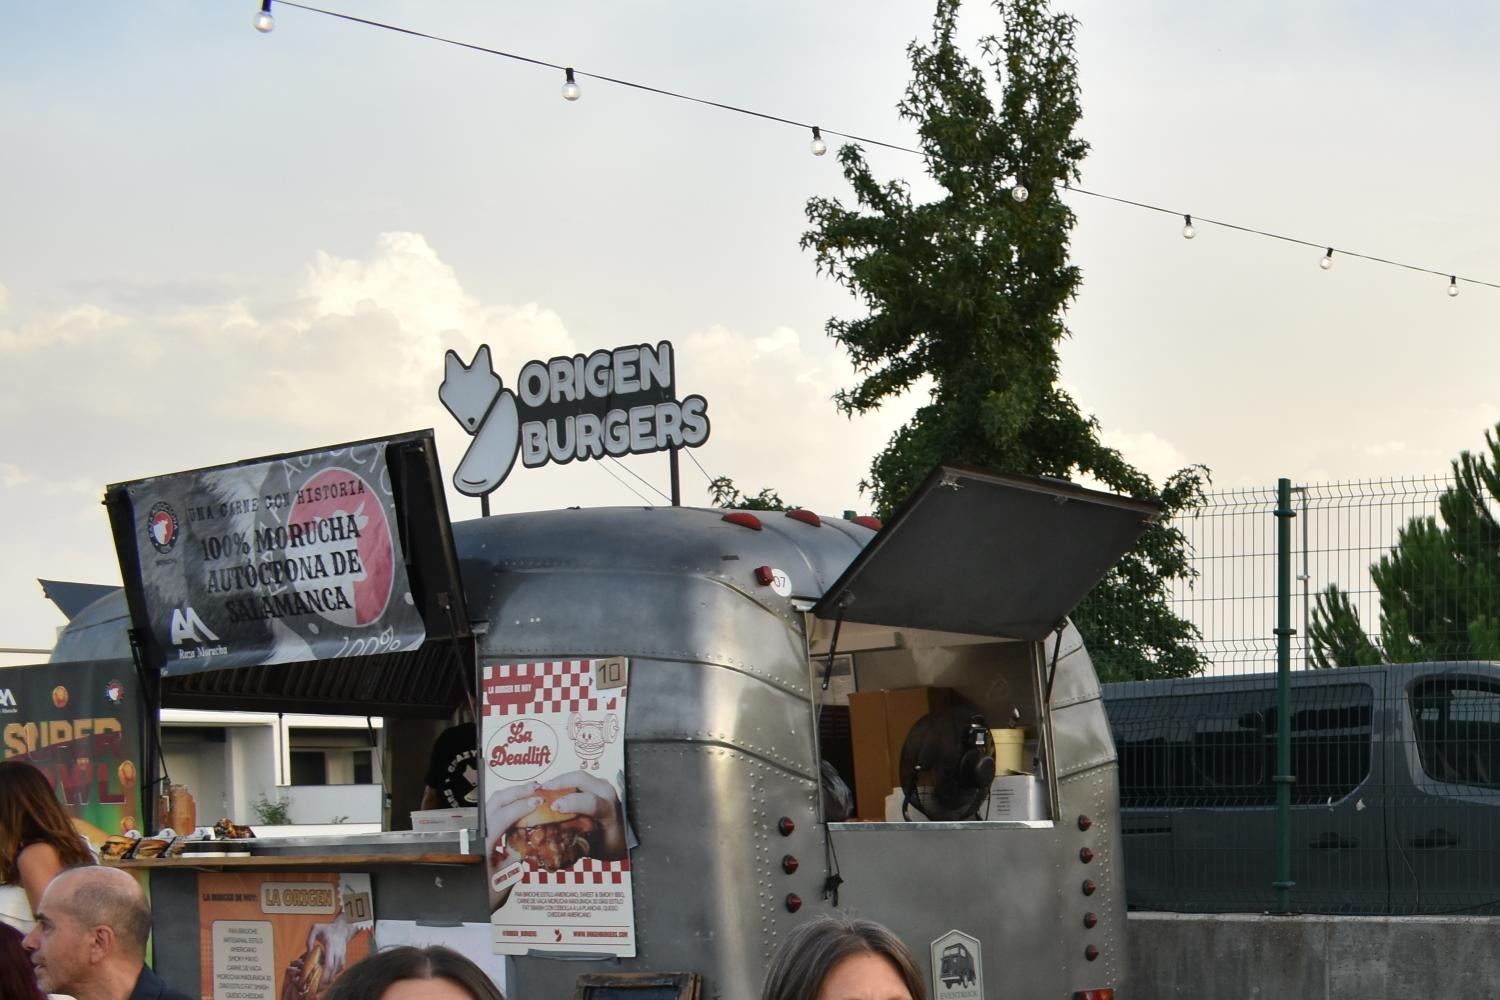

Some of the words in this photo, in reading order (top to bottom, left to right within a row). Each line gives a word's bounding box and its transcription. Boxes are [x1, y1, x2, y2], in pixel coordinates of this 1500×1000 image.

[519, 342, 672, 408] ORIGEN
[521, 397, 708, 466] BURGERS
[188, 505, 214, 522] UNA
[220, 498, 259, 516] CARNE
[265, 492, 290, 508] CON
[296, 479, 366, 506] HISTORIA
[201, 534, 250, 562] 100%
[255, 514, 361, 554] MORUCHA
[208, 554, 329, 594] AUTÓCTONA
[332, 549, 362, 577] DE
[229, 586, 352, 624] SALAMANCA
[598, 663, 621, 684] 10
[507, 722, 532, 744] La
[490, 744, 551, 767] Deadlift
[265, 889, 281, 907] LA
[282, 889, 332, 907] ORIGEN
